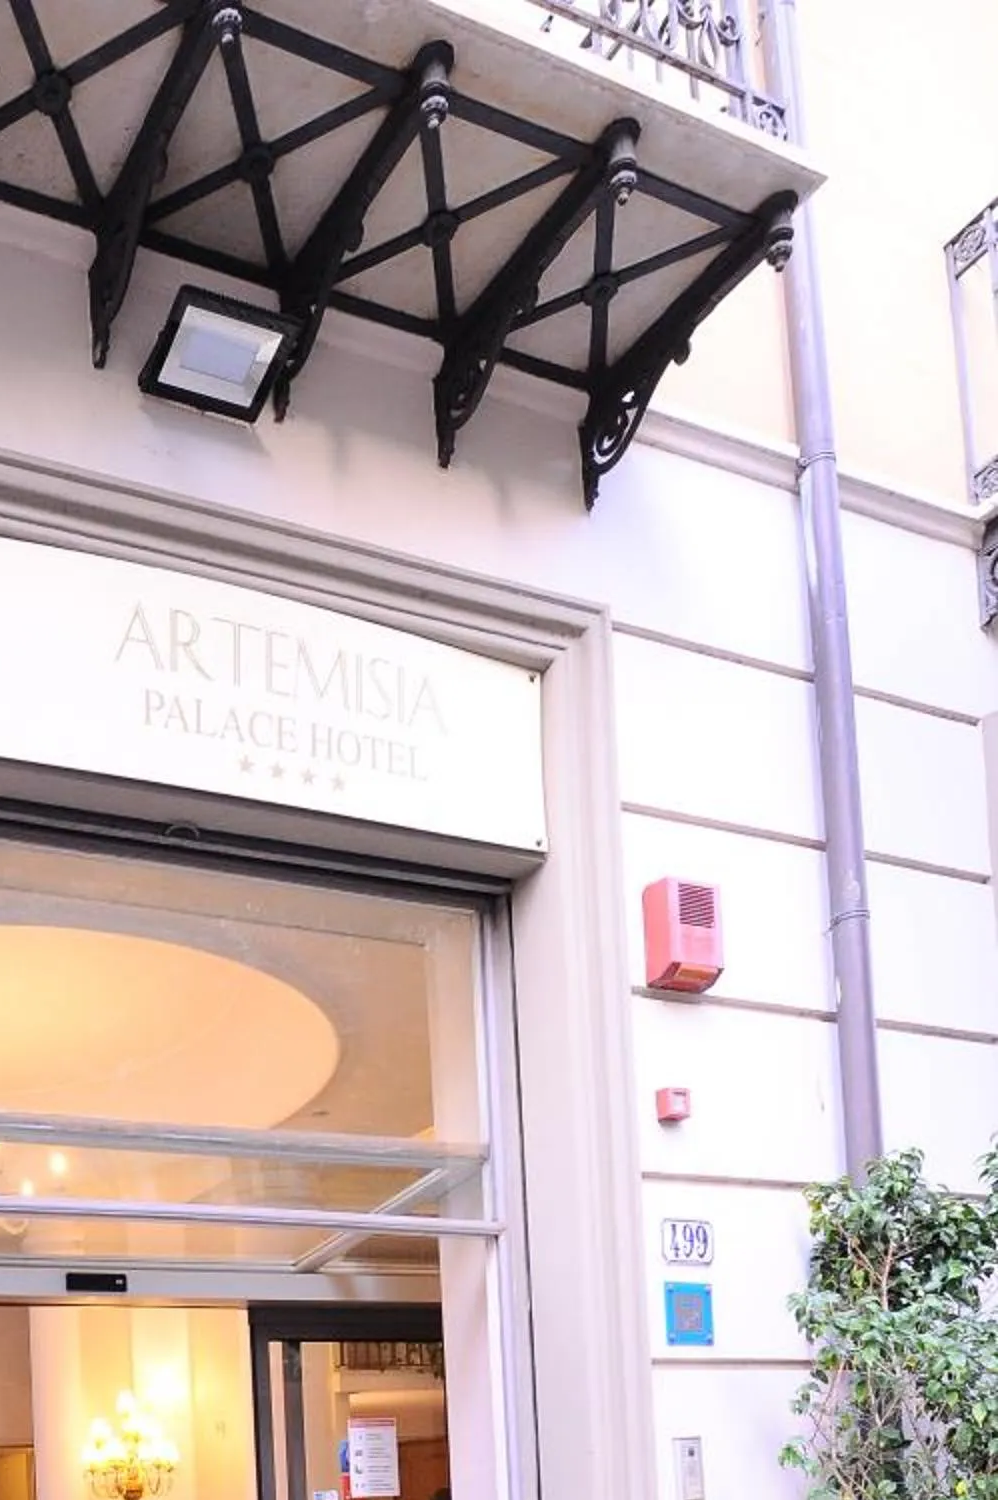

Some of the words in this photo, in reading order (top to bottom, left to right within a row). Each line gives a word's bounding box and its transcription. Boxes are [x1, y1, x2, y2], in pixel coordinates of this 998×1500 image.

[115, 601, 449, 735] ARTEMISIA
[142, 686, 298, 754] PALACE
[311, 721, 428, 781] HOTEL
[670, 1223, 708, 1259] 499
